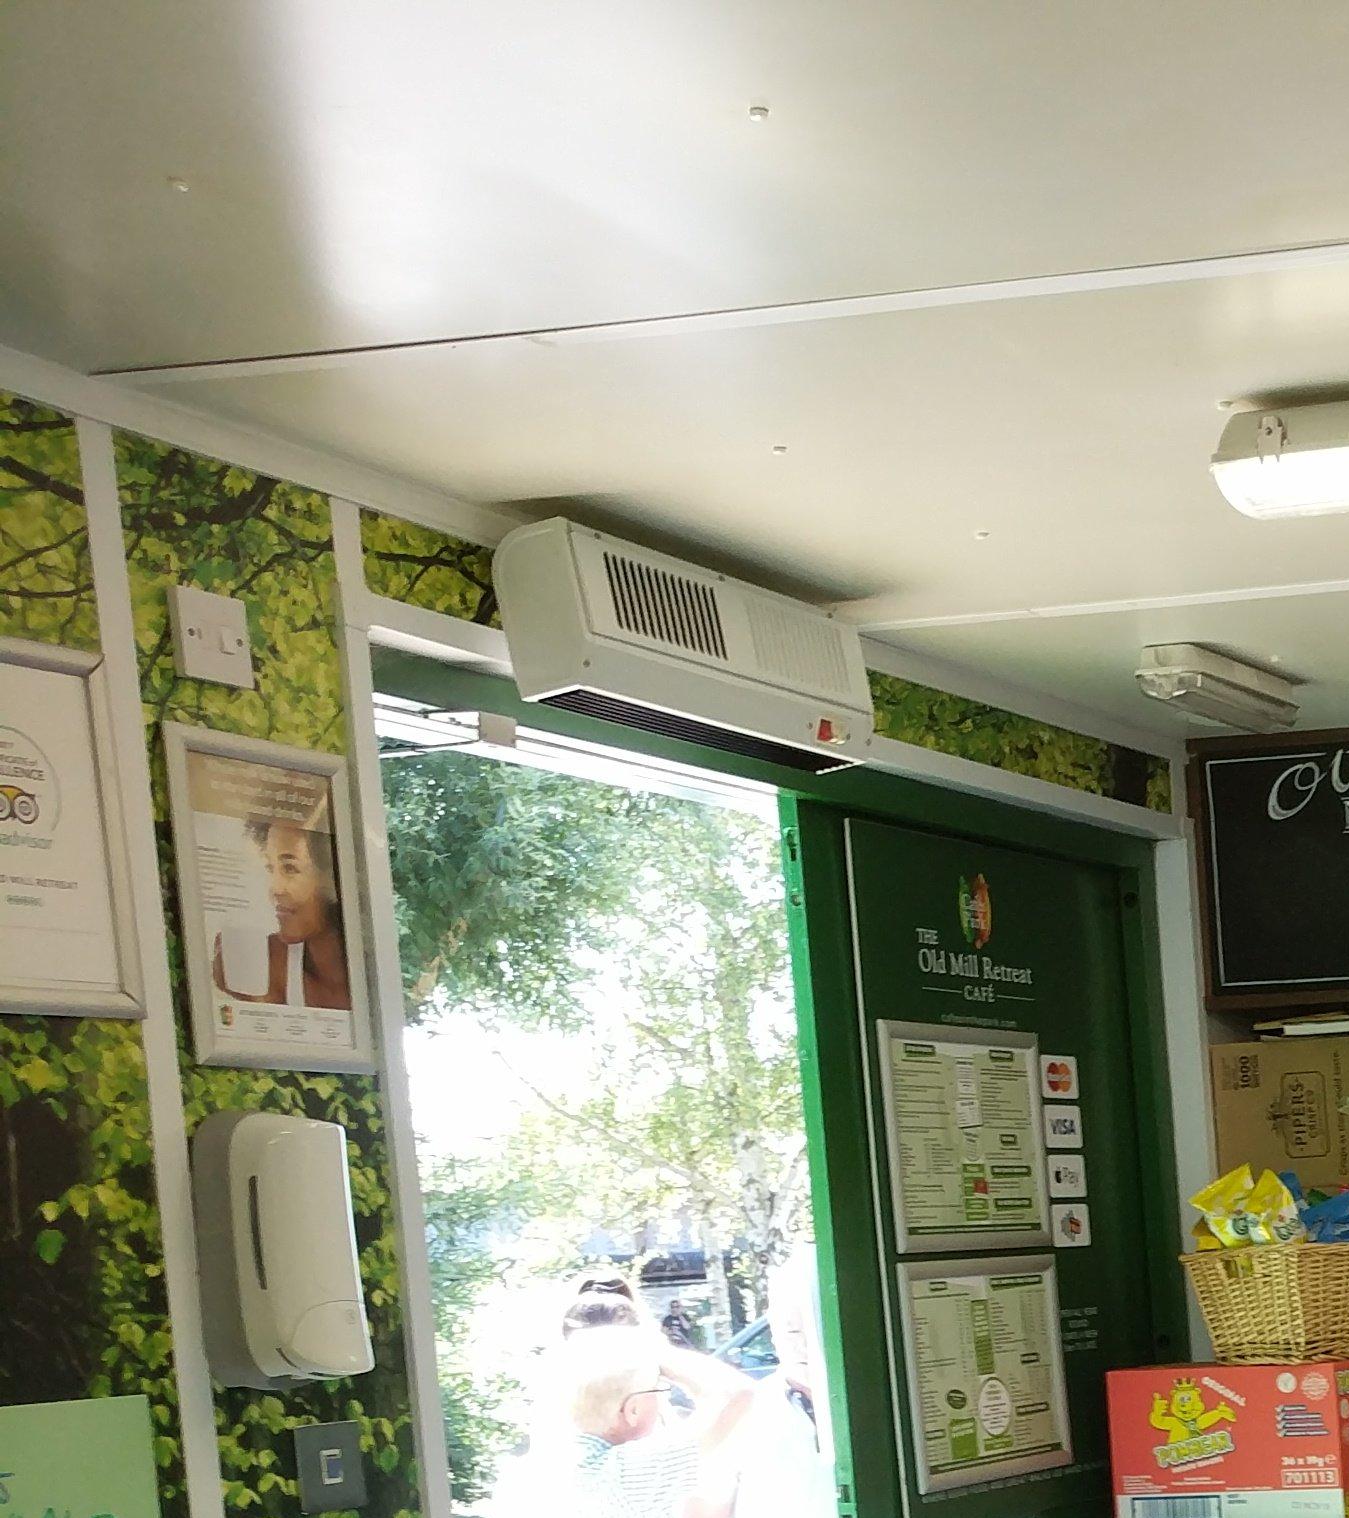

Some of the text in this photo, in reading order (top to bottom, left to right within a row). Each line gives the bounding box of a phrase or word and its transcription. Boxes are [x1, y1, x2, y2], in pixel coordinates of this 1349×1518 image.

[915, 927, 939, 945] THE
[918, 948, 1033, 985] Old Mill Retreat
[1284, 1470, 1336, 1485] 701113
